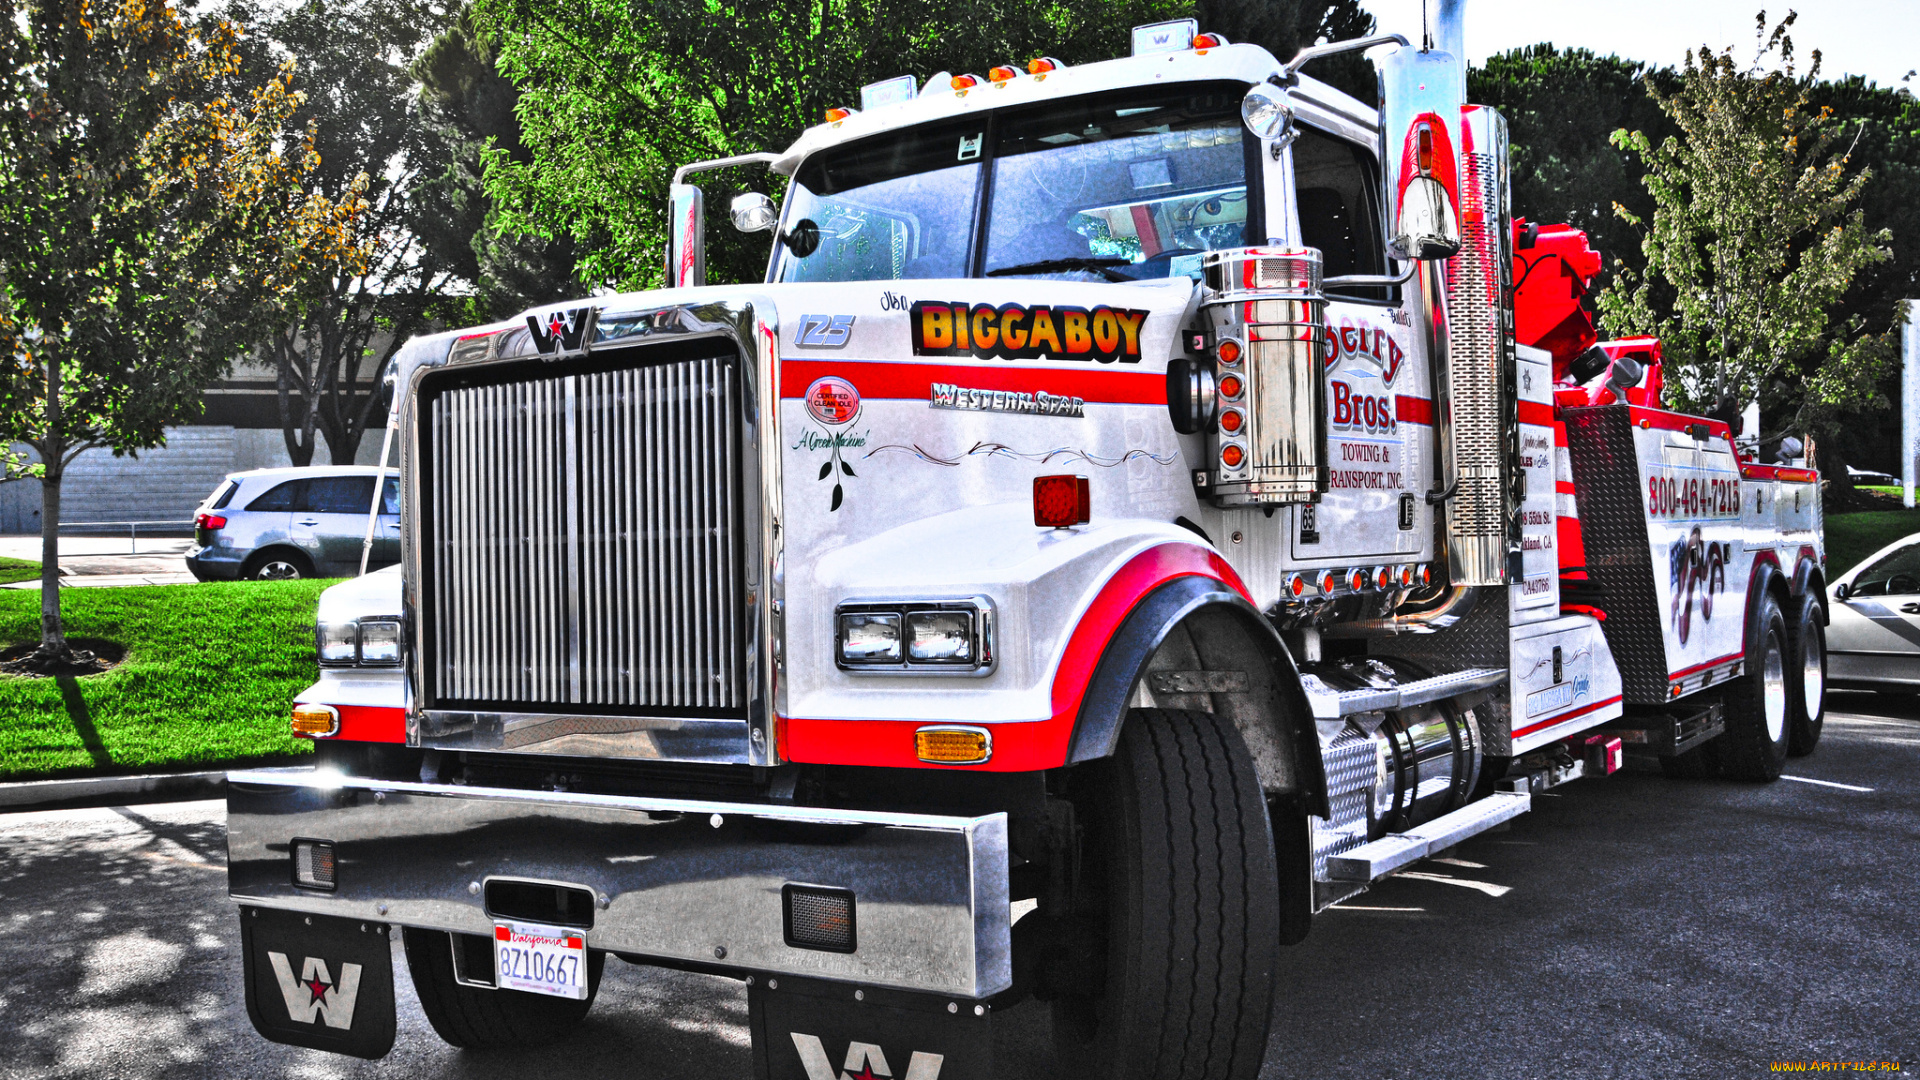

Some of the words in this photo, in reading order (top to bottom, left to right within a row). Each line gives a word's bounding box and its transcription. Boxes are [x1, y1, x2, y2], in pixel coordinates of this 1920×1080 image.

[1153, 33, 1170, 45] W
[526, 307, 590, 355] W
[793, 314, 856, 350] 125
[816, 392, 849, 400] CERTIFIED
[1331, 380, 1397, 433] Bros.
[1341, 443, 1380, 463] TOWING
[1382, 445, 1390, 463] &
[1330, 470, 1386, 491] RANSPORT,
[1387, 472, 1405, 490] INC.
[1649, 476, 1740, 517] 800-464-7215
[1302, 508, 1314, 530] 65
[1528, 511, 1543, 525] 55th
[1543, 511, 1552, 525] St.
[1543, 535, 1553, 549] CA
[512, 933, 569, 949] California
[500, 946, 579, 986] 8Z10667
[267, 951, 363, 1031] W
